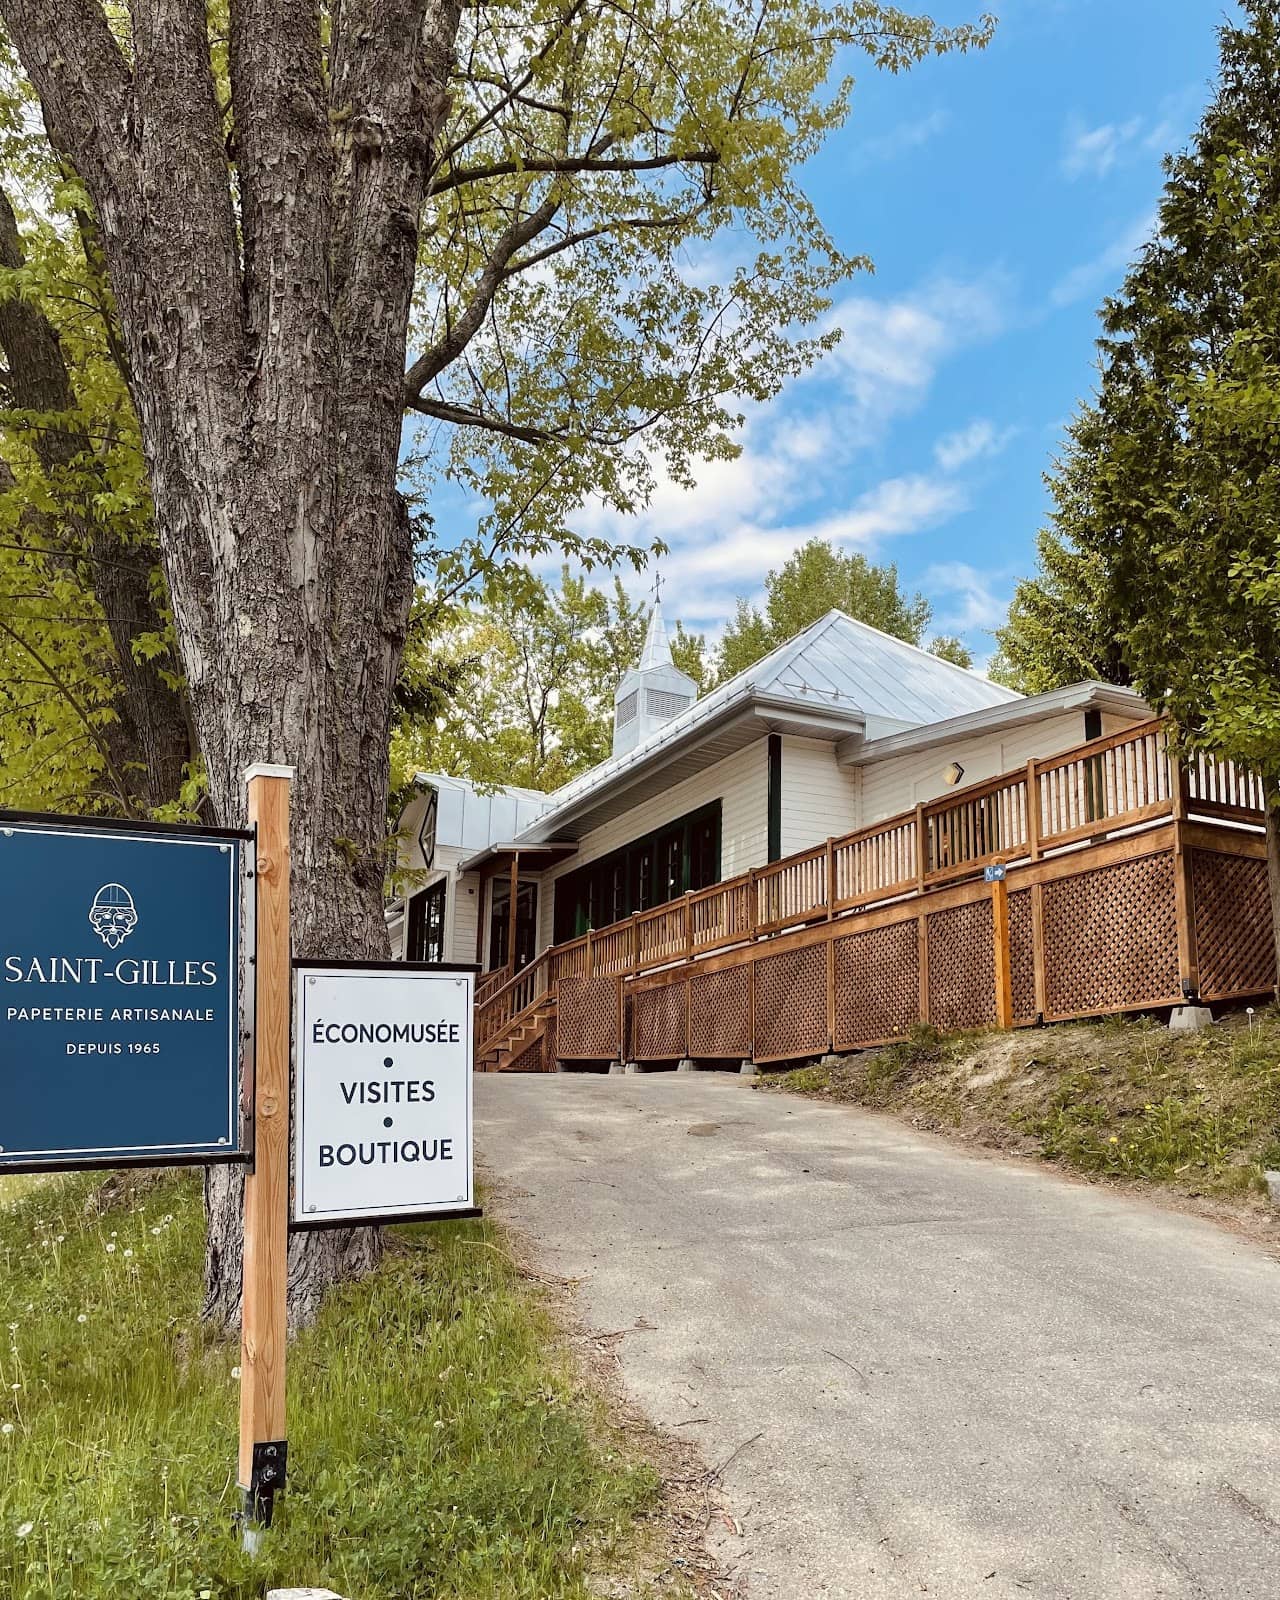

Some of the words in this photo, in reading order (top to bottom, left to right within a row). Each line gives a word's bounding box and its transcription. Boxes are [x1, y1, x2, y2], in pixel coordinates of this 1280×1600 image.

[4, 956, 217, 987] SAINT-GILLES
[7, 1007, 103, 1021] PAPETERIE
[110, 1008, 214, 1021] ARTISANALE
[312, 1018, 460, 1044] ÉCONOMUSÉE
[66, 1043, 122, 1055] DEPUIS
[127, 1043, 161, 1054] 1965
[339, 1080, 435, 1104] VISITES
[319, 1138, 453, 1168] BOUTIQUE
